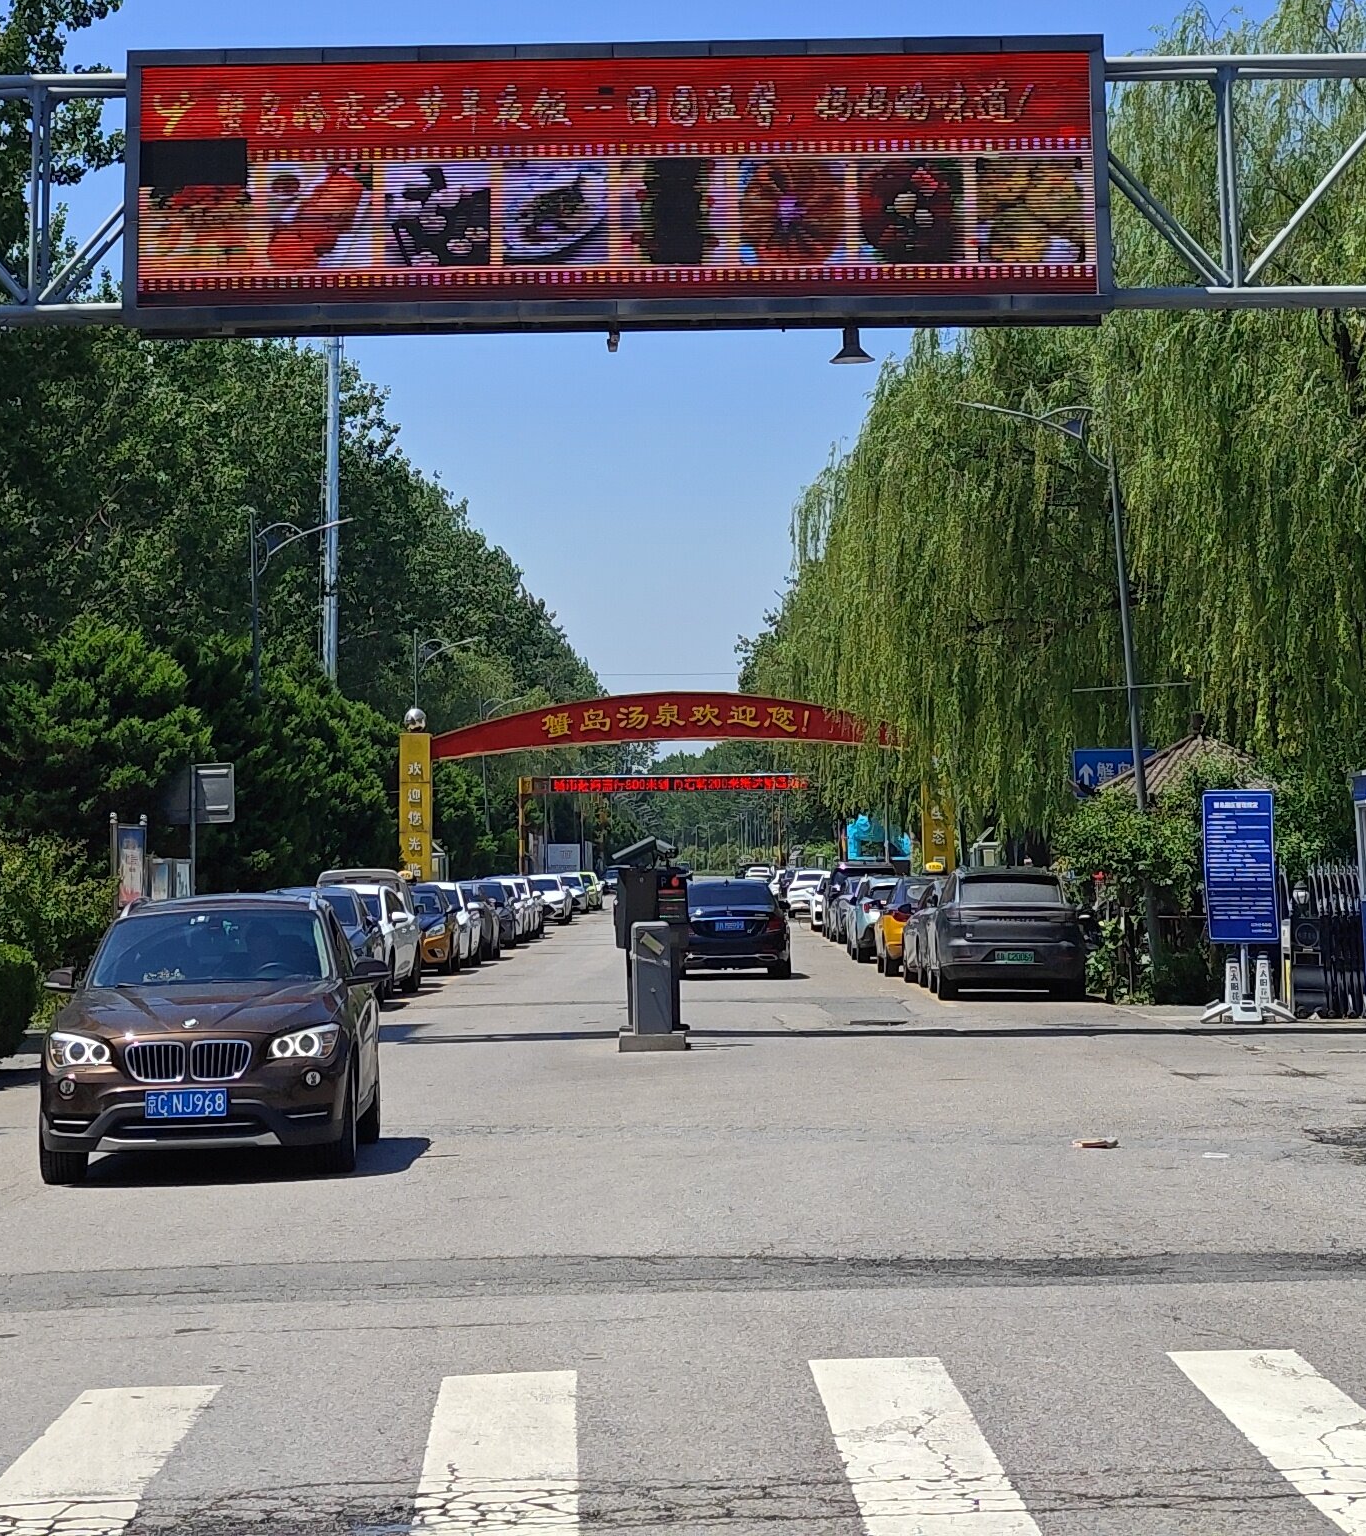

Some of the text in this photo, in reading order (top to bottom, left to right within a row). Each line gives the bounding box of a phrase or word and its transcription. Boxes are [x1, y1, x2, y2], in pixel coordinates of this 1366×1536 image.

[541, 701, 811, 739] 蟹岛汤泉欢迎您!
[406, 761, 423, 877] 欢迎您光临
